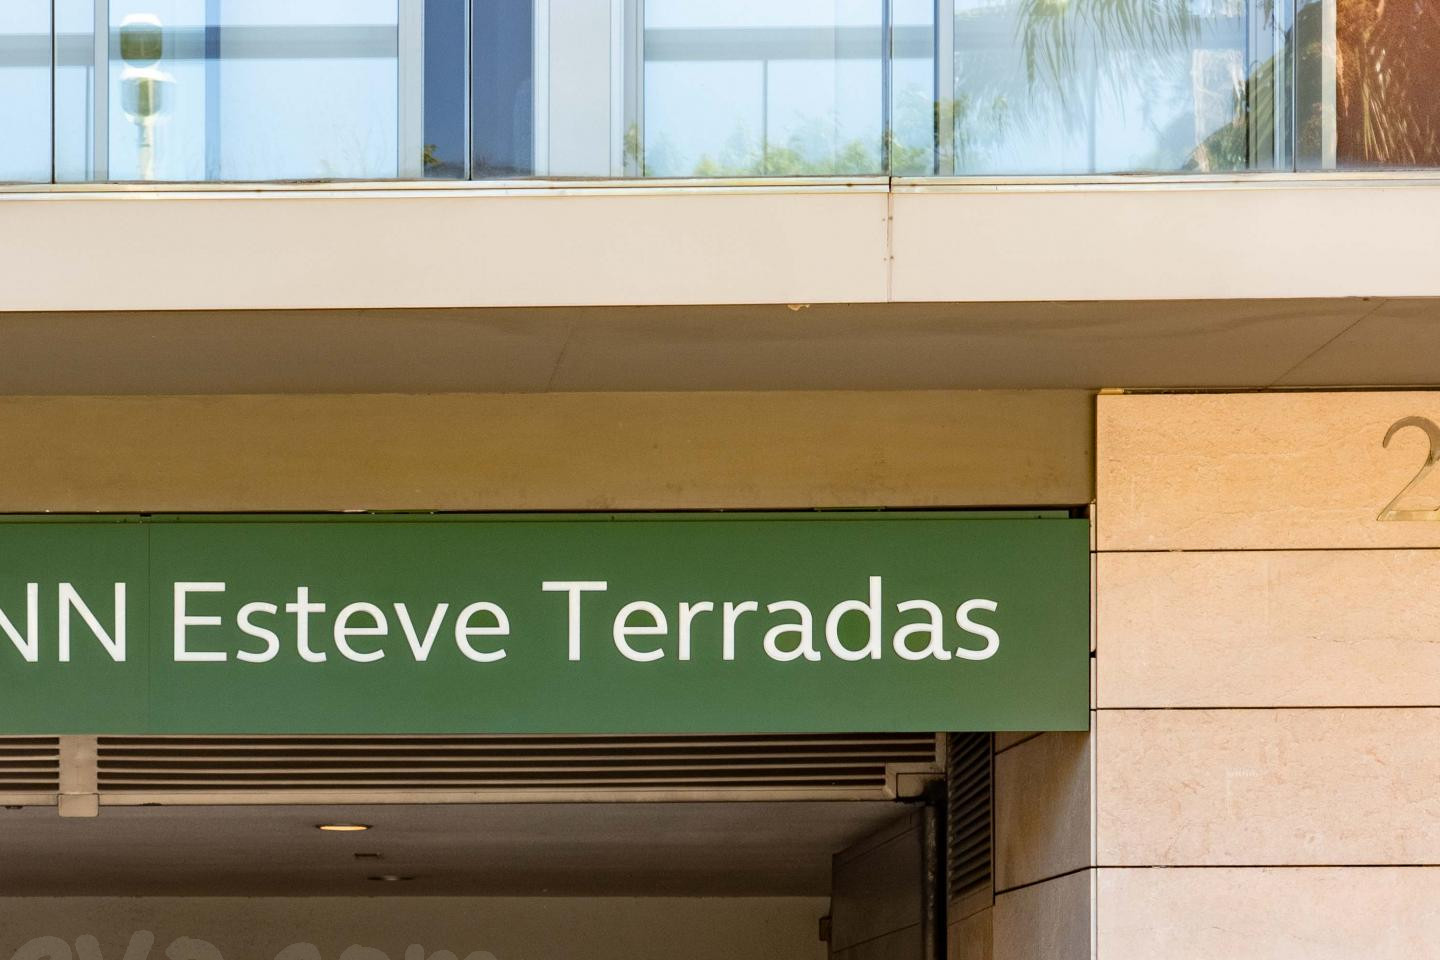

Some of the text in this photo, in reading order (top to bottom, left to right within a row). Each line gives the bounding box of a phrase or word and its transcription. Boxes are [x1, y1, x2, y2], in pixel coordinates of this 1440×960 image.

[1376, 415, 1440, 522] 2
[173, 581, 511, 664] Esteve
[542, 575, 1001, 662] Terradas
